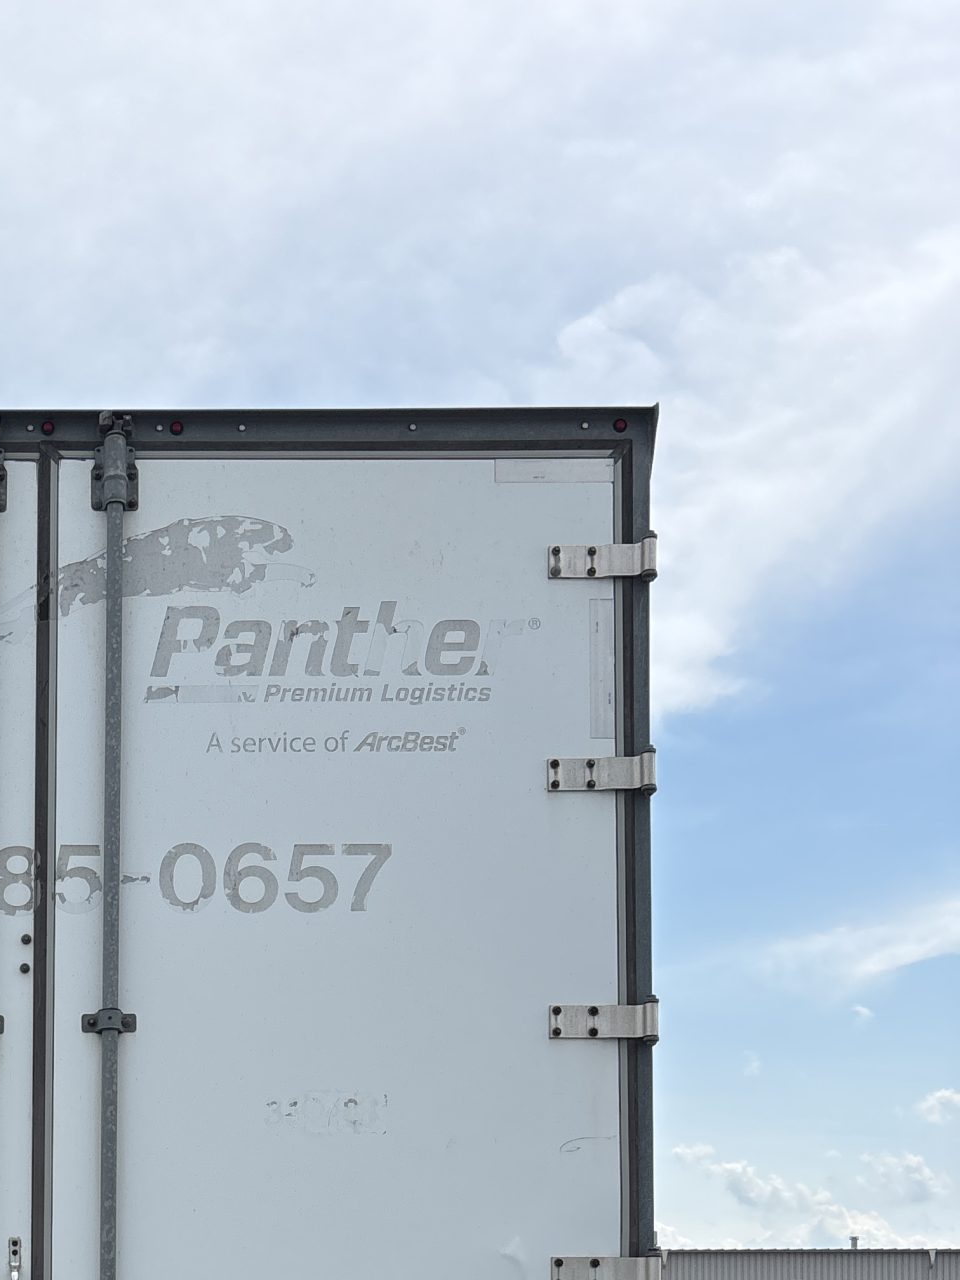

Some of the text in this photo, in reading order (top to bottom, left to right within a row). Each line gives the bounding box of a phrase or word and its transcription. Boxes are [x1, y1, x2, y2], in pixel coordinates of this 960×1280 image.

[263, 682, 492, 706] Premium Logistics
[206, 731, 224, 753] A
[230, 731, 317, 753] service
[324, 730, 350, 753] of
